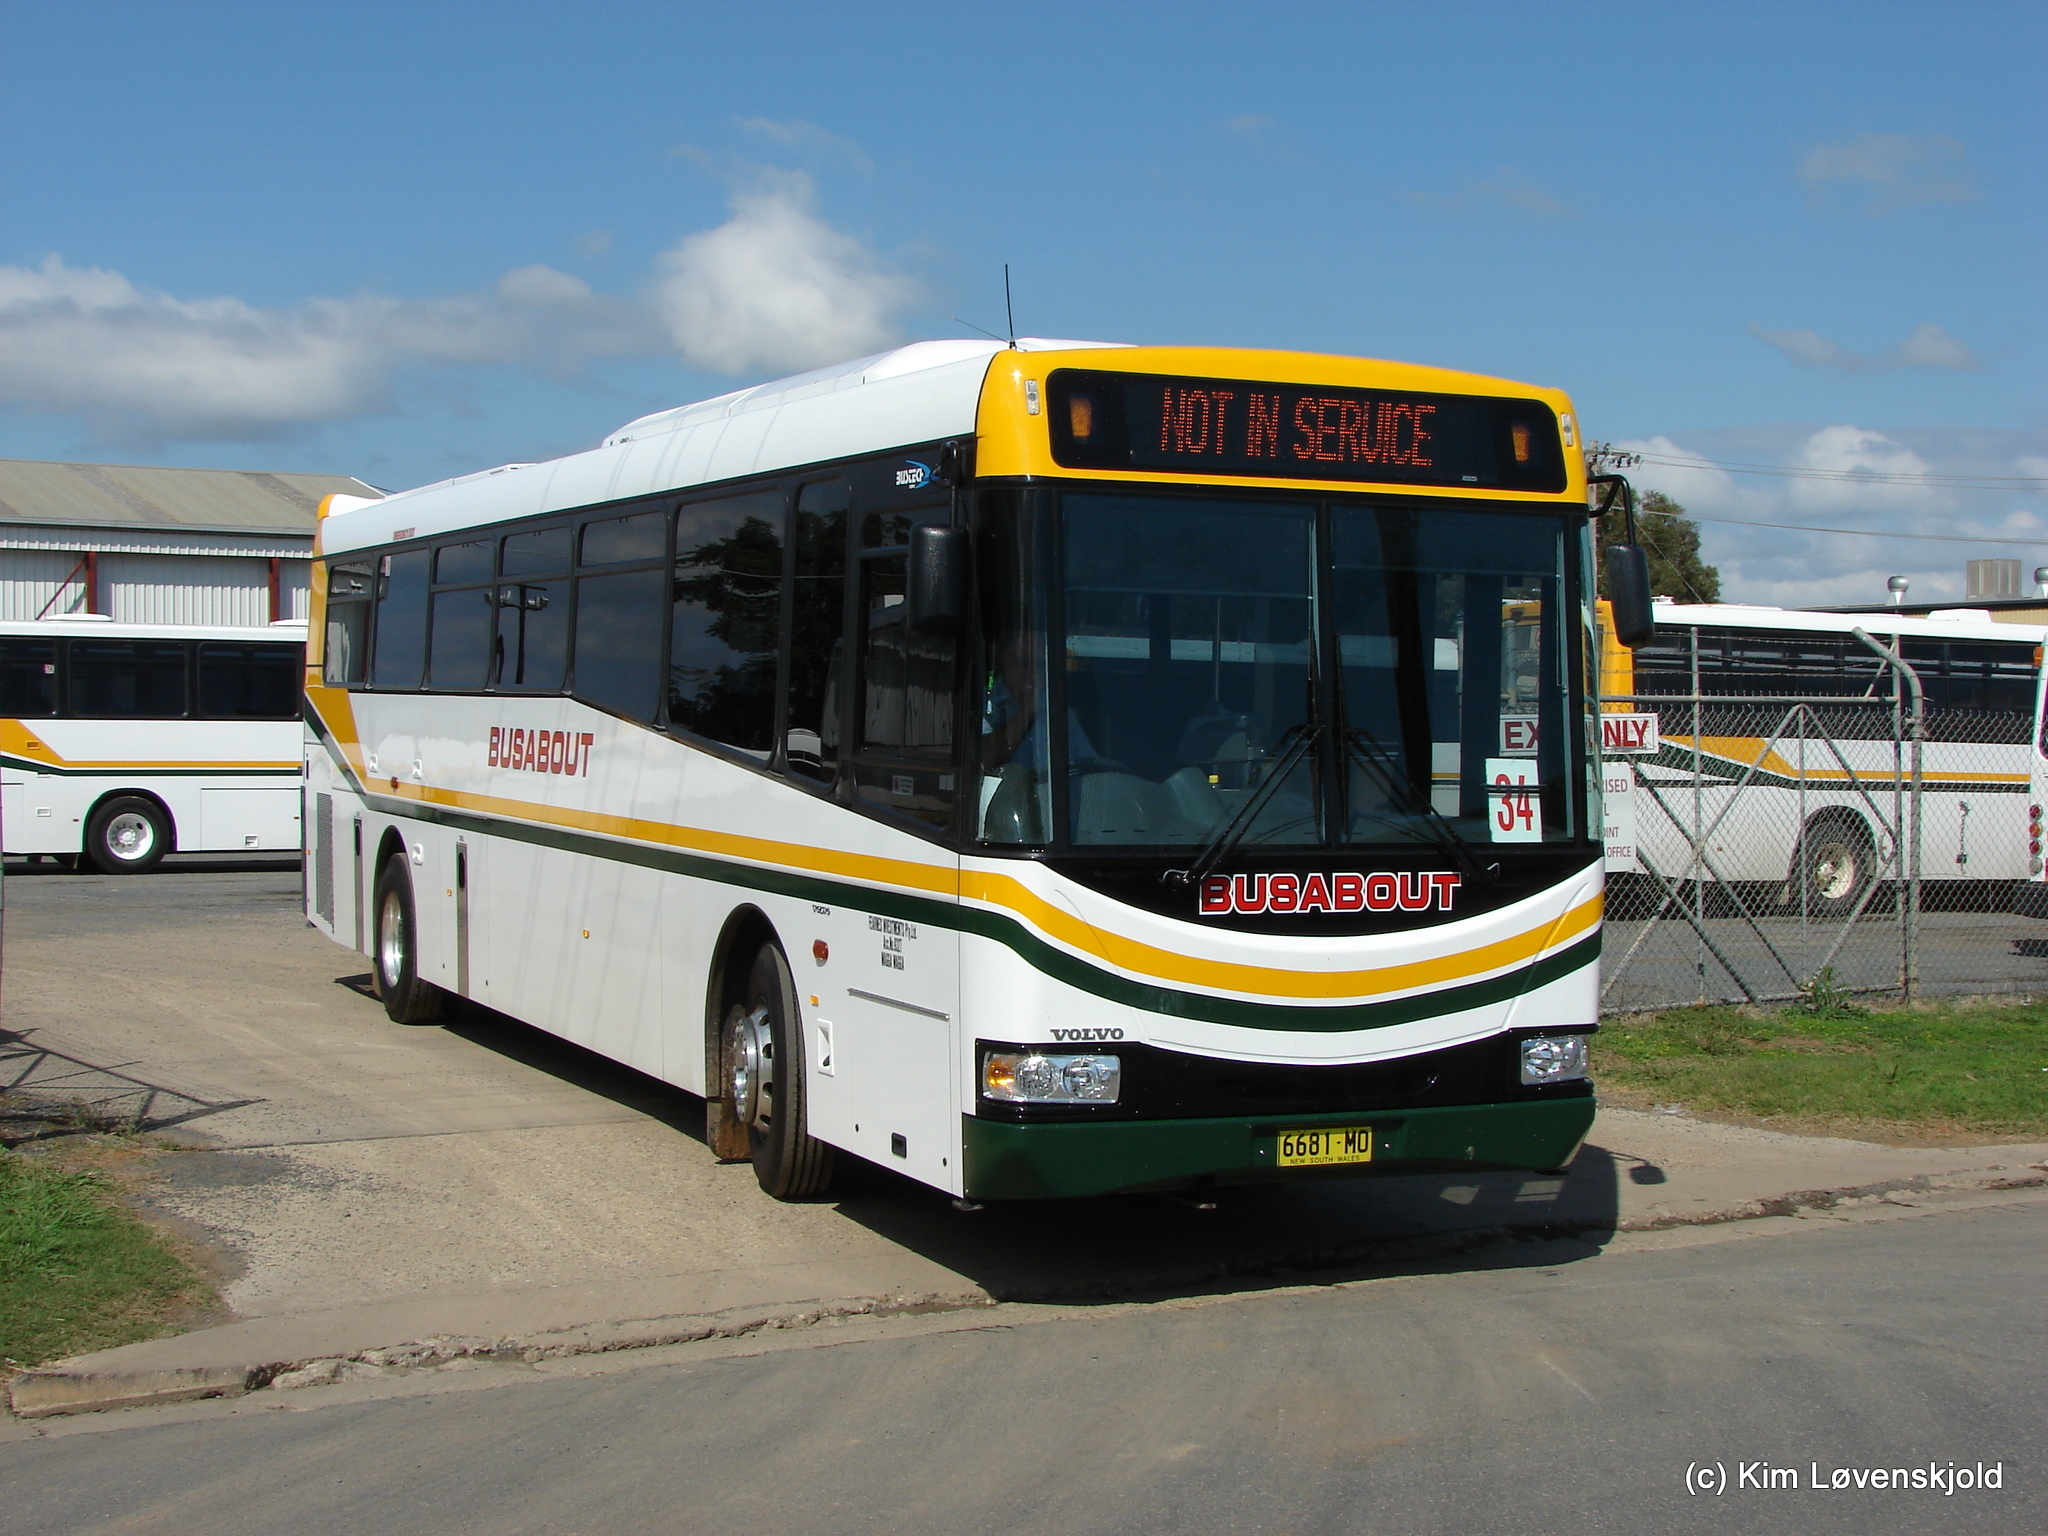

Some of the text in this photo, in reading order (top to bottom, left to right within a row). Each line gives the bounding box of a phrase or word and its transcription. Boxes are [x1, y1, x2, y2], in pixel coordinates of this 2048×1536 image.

[1162, 388, 1436, 466] NOT IN SERVICE
[488, 726, 594, 778] BUSABOUT
[1602, 720, 1649, 747] NLY
[1495, 774, 1534, 832] 34
[1606, 846, 1631, 858] OFFICE
[1199, 872, 1462, 915] BUSABOUT
[1050, 1028, 1124, 1041] VOLVO
